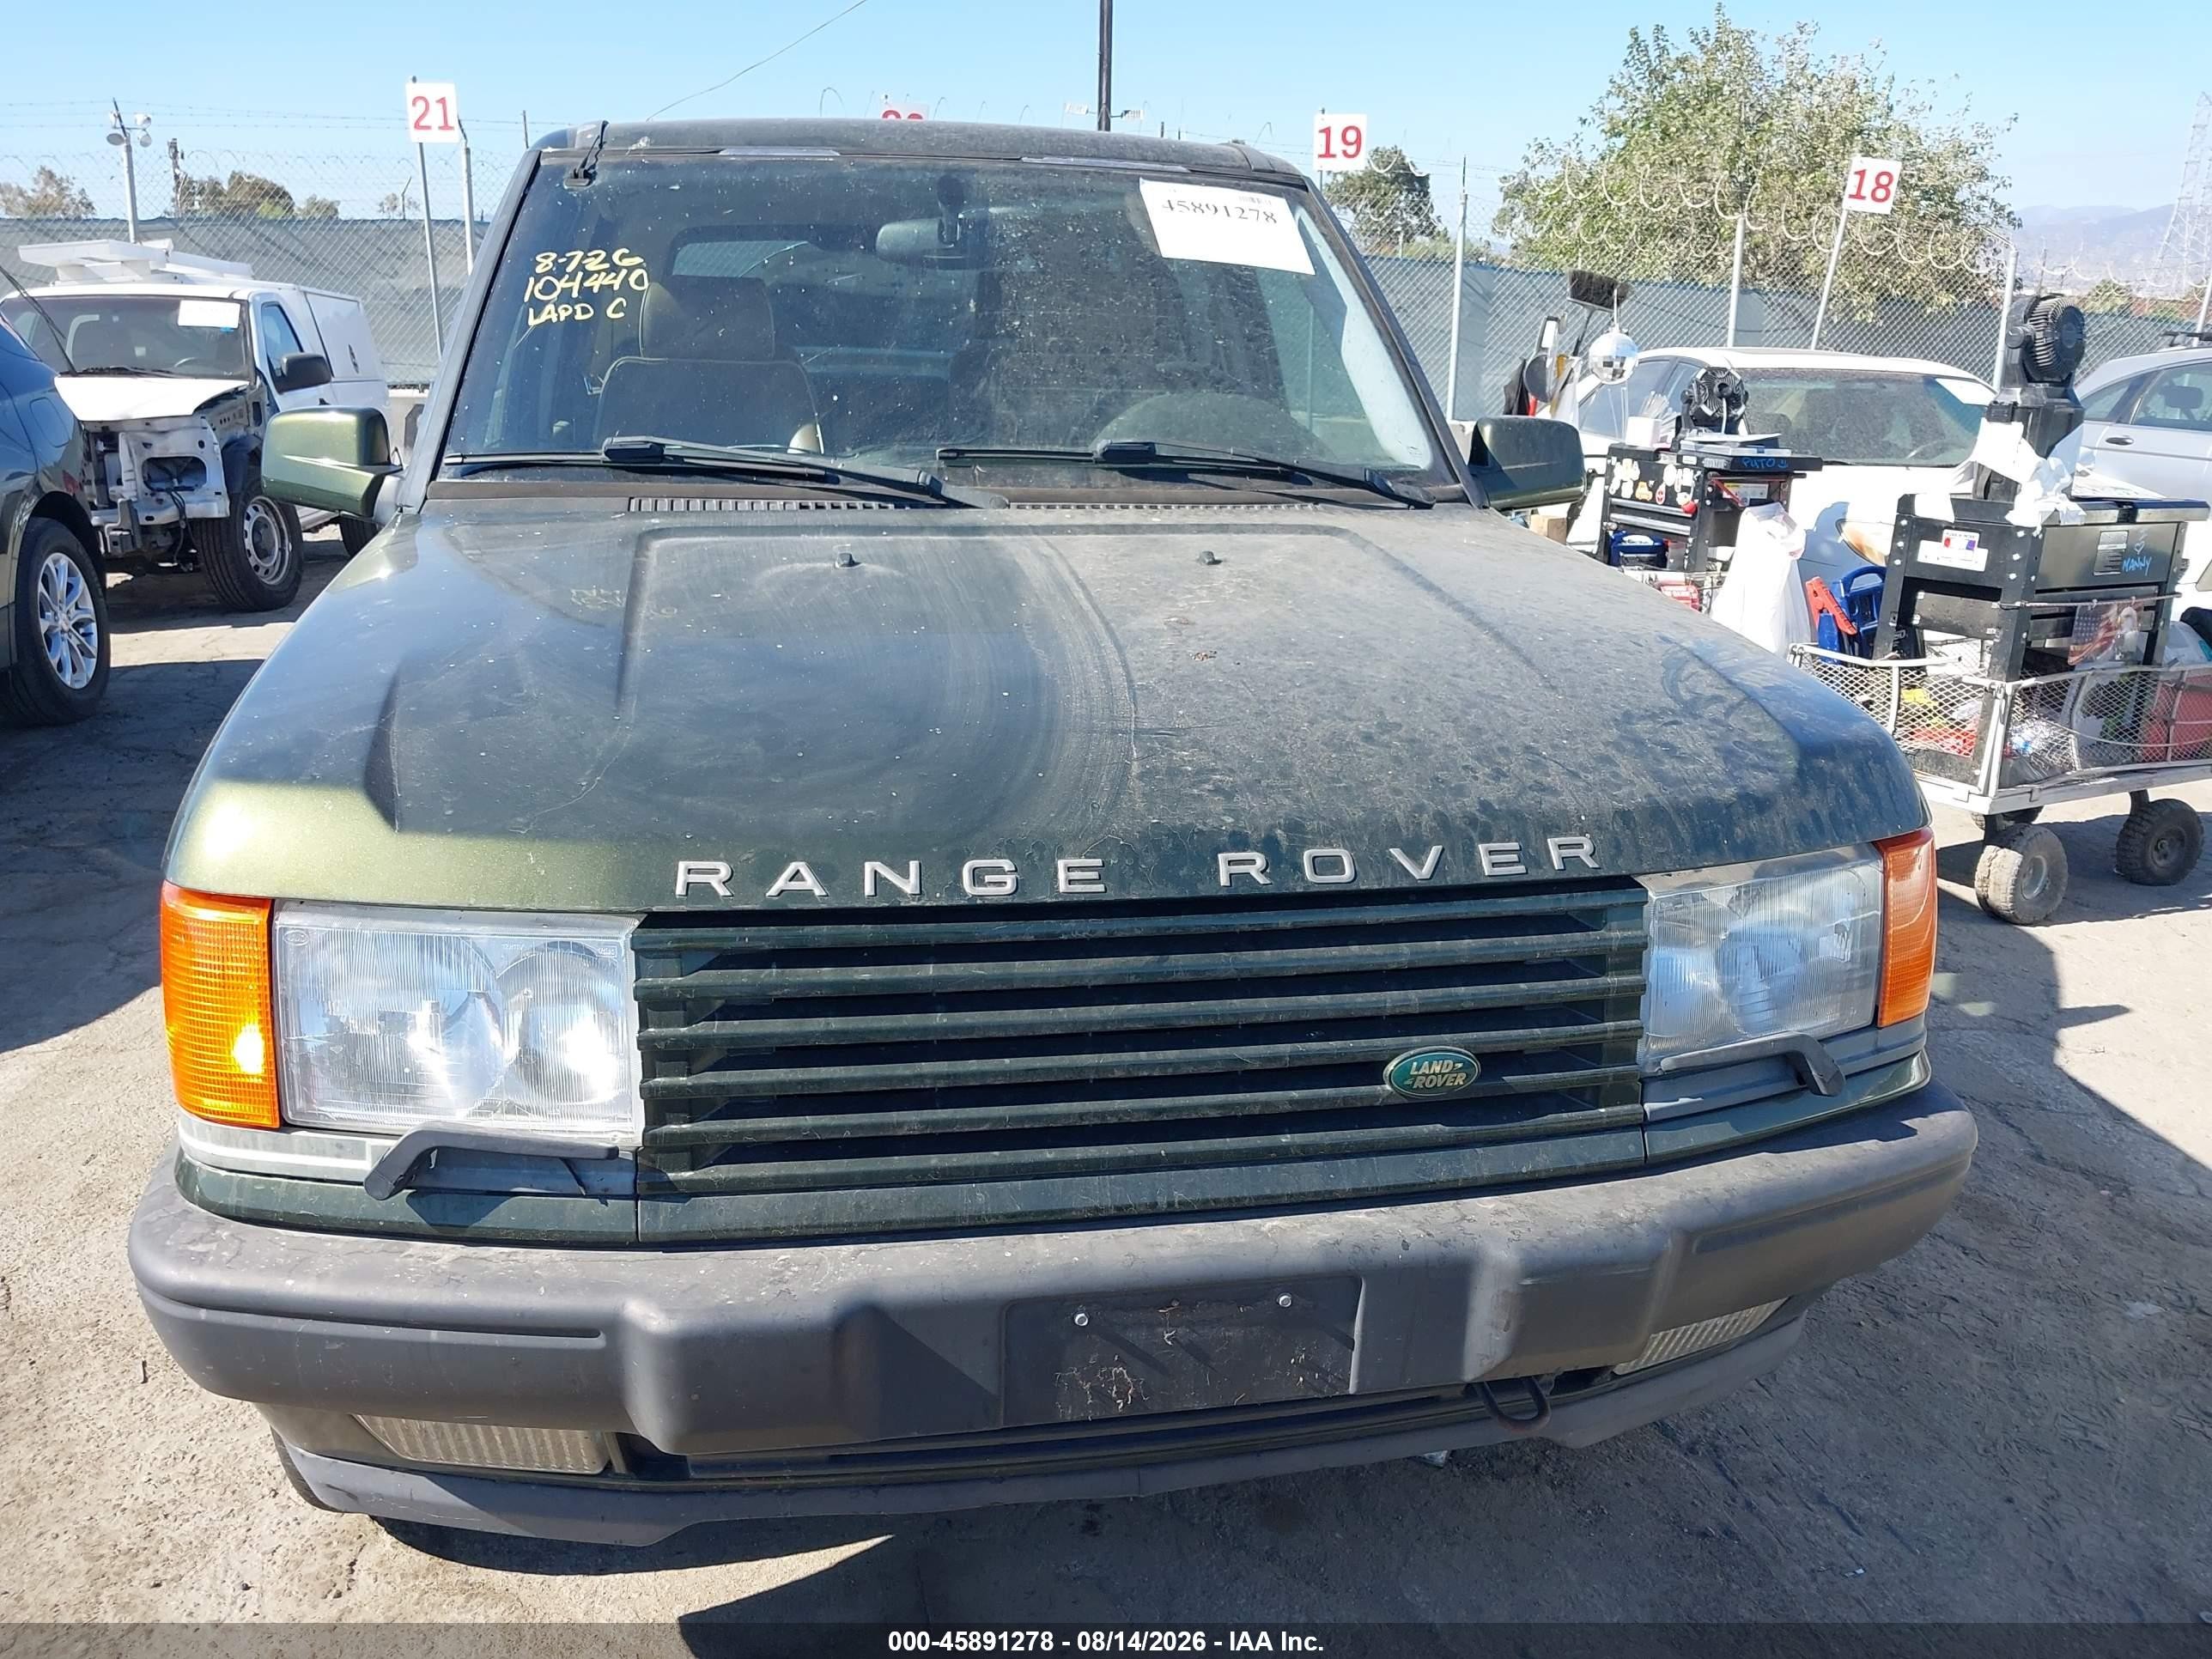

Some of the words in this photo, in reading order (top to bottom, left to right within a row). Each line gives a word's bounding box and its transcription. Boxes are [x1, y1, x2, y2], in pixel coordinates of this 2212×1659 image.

[411, 95, 455, 131] 21
[1317, 125, 1362, 159] 19
[1847, 168, 1894, 204] 18
[1162, 198, 1279, 224] 45891278
[527, 302, 595, 326] LAPD
[674, 858, 1107, 897] RANGE
[1217, 836, 1601, 887] ROVER
[1409, 1059, 1455, 1075] LAND
[1412, 1072, 1467, 1089] ROVER
